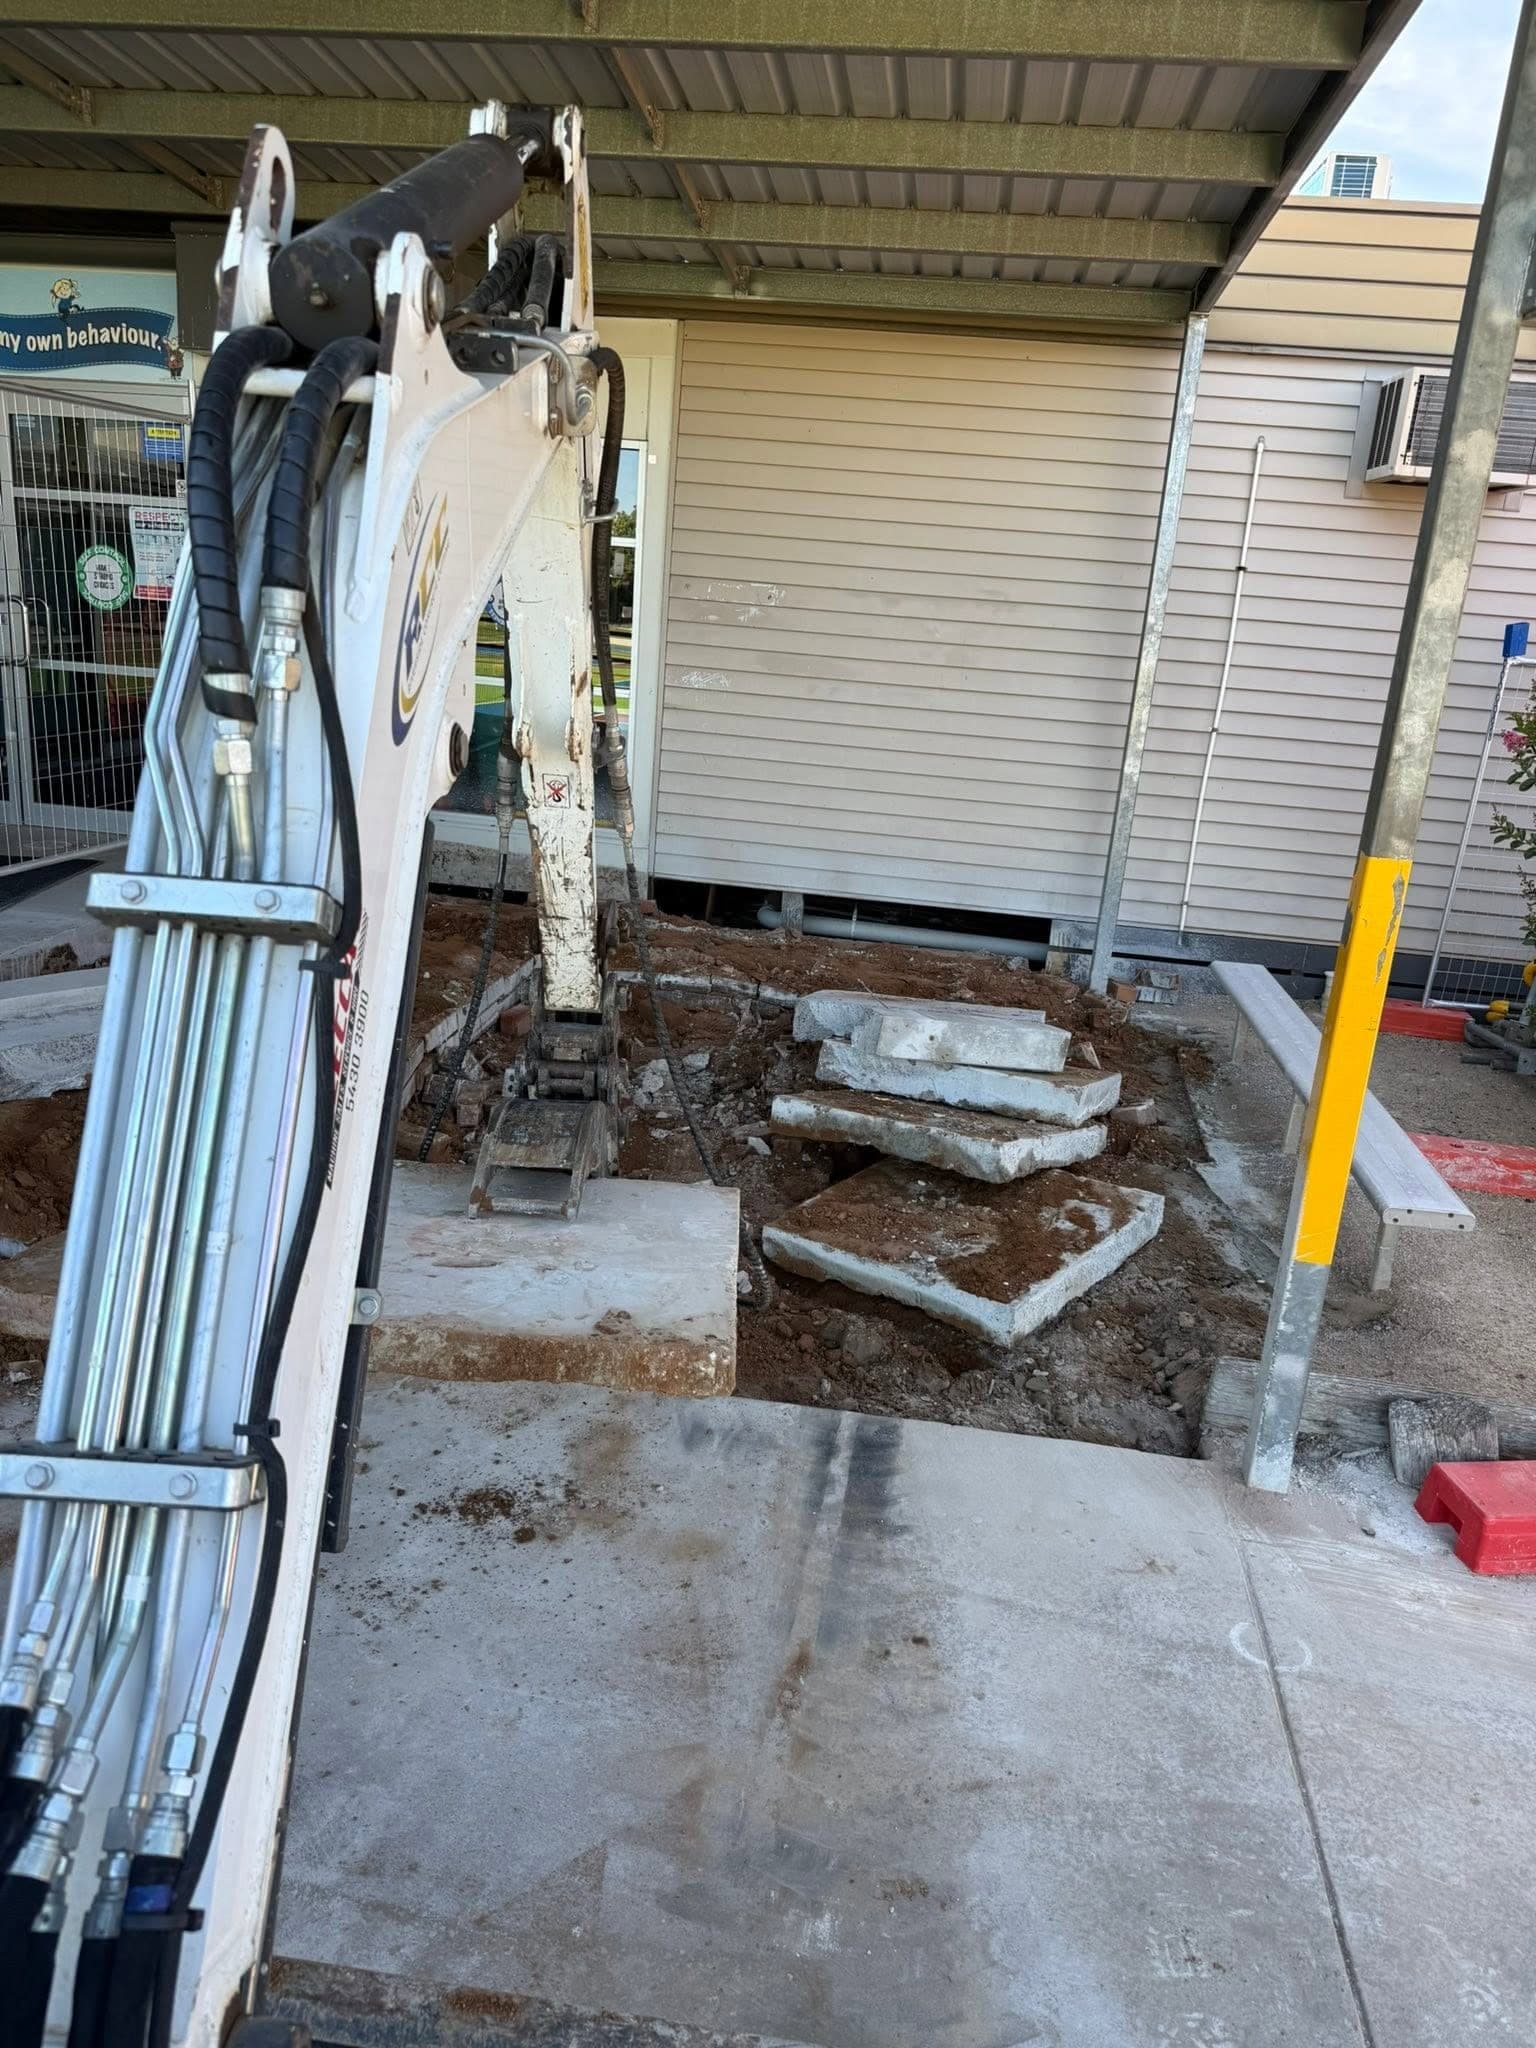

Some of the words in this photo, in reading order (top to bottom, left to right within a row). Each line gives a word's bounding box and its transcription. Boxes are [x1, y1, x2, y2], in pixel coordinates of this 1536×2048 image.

[26, 333, 63, 351] own
[66, 323, 162, 350] behaviour.
[345, 1055, 362, 1112] 5430
[355, 989, 370, 1048] 3900
